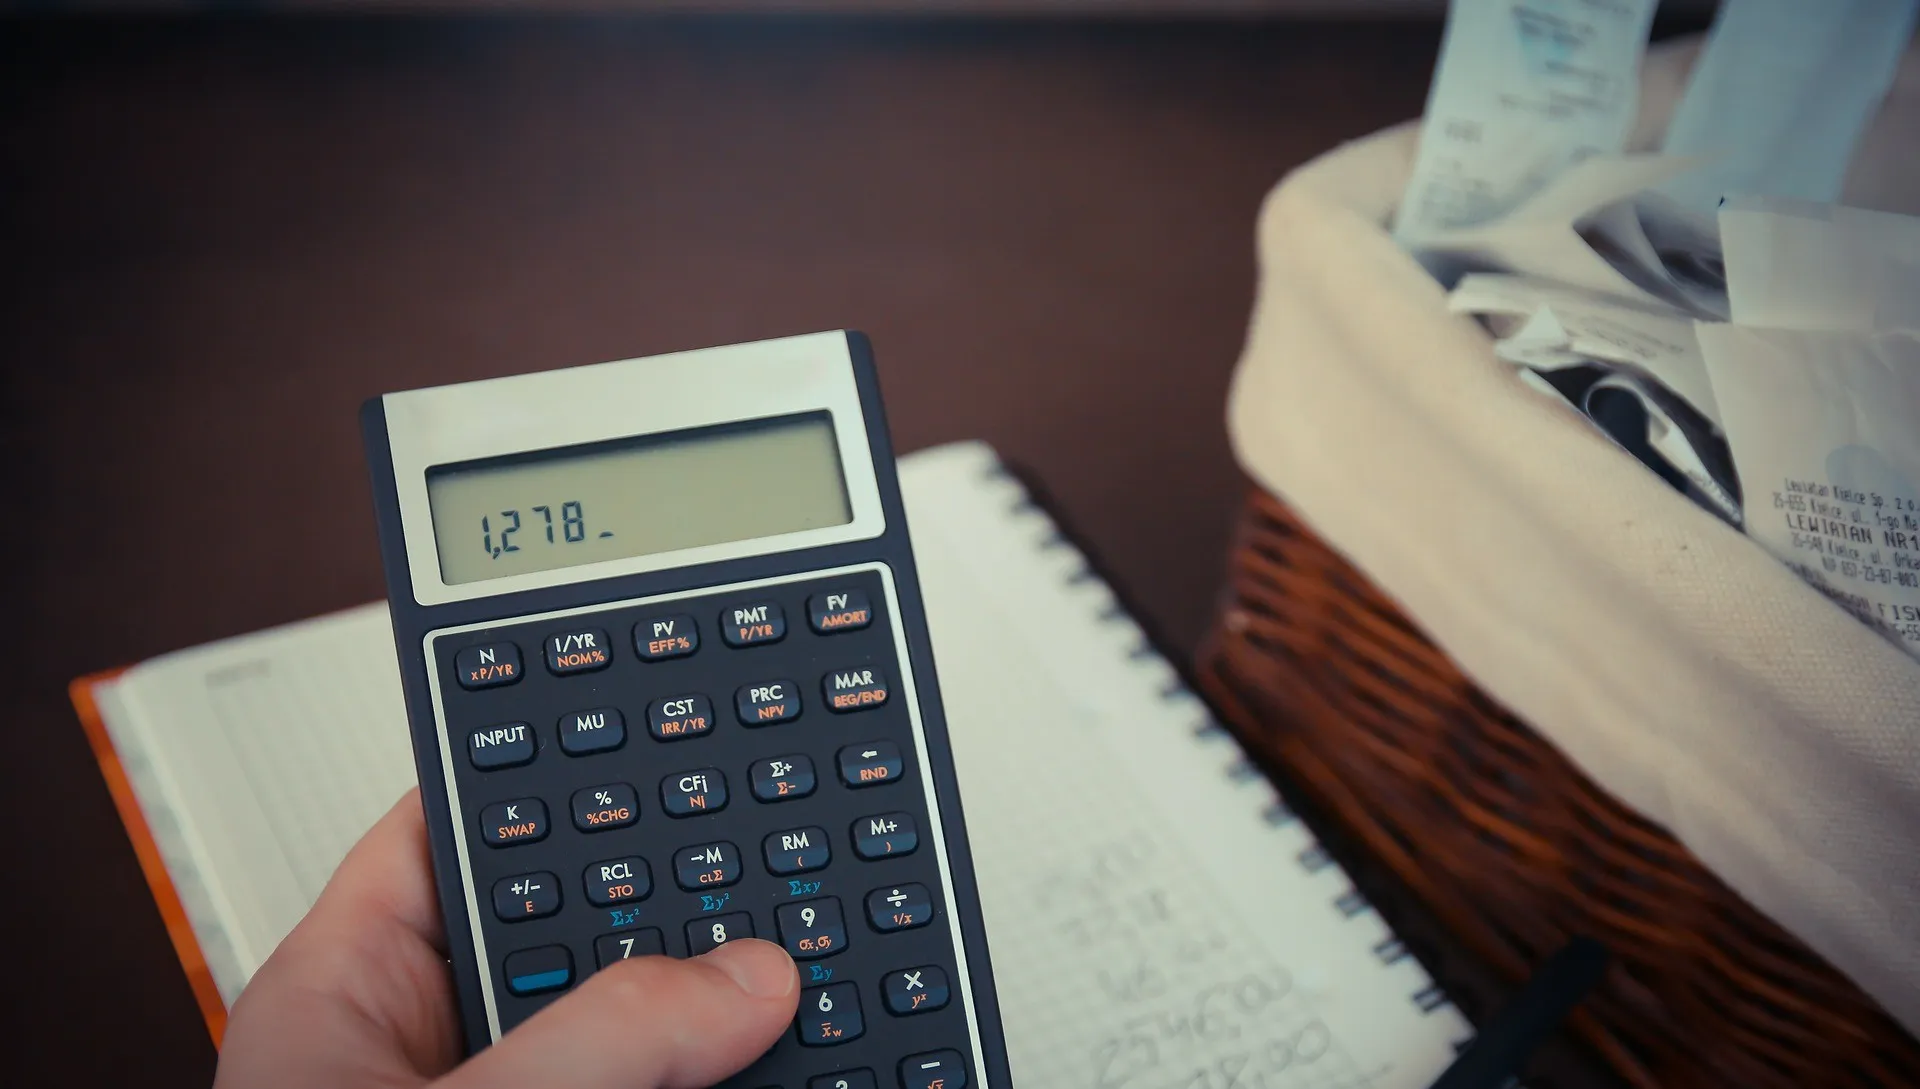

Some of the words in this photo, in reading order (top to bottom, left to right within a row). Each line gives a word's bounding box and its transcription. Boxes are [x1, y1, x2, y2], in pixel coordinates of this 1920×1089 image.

[1786, 513, 1873, 544] LEWIATAN
[826, 593, 848, 612] FV
[734, 605, 768, 625] PMT
[821, 609, 867, 628] AMORT
[652, 620, 675, 638] PV
[740, 624, 774, 641] P/YR
[554, 633, 596, 653] I/YR
[649, 637, 691, 654] EFF%
[479, 648, 496, 665] N
[556, 650, 606, 667] NOM%
[835, 670, 875, 690] MAR
[750, 684, 784, 704] PRC
[834, 689, 886, 708] BEG/END
[662, 698, 695, 719] CST
[758, 704, 786, 721] NPV
[577, 713, 605, 733] MU
[661, 717, 706, 735] IRR/YR
[474, 725, 525, 749] INPUT
[860, 766, 887, 780] RND
[506, 805, 520, 822] K
[587, 808, 630, 825] %CHG
[499, 823, 537, 839] SWAP
[870, 818, 898, 837] M+
[781, 831, 811, 851] RM
[600, 862, 634, 882] RCL
[608, 884, 634, 900] STO
[524, 900, 534, 912] E
[800, 907, 816, 928] 9
[711, 923, 728, 944] 8
[619, 938, 636, 960] 7
[818, 991, 834, 1013] 6
